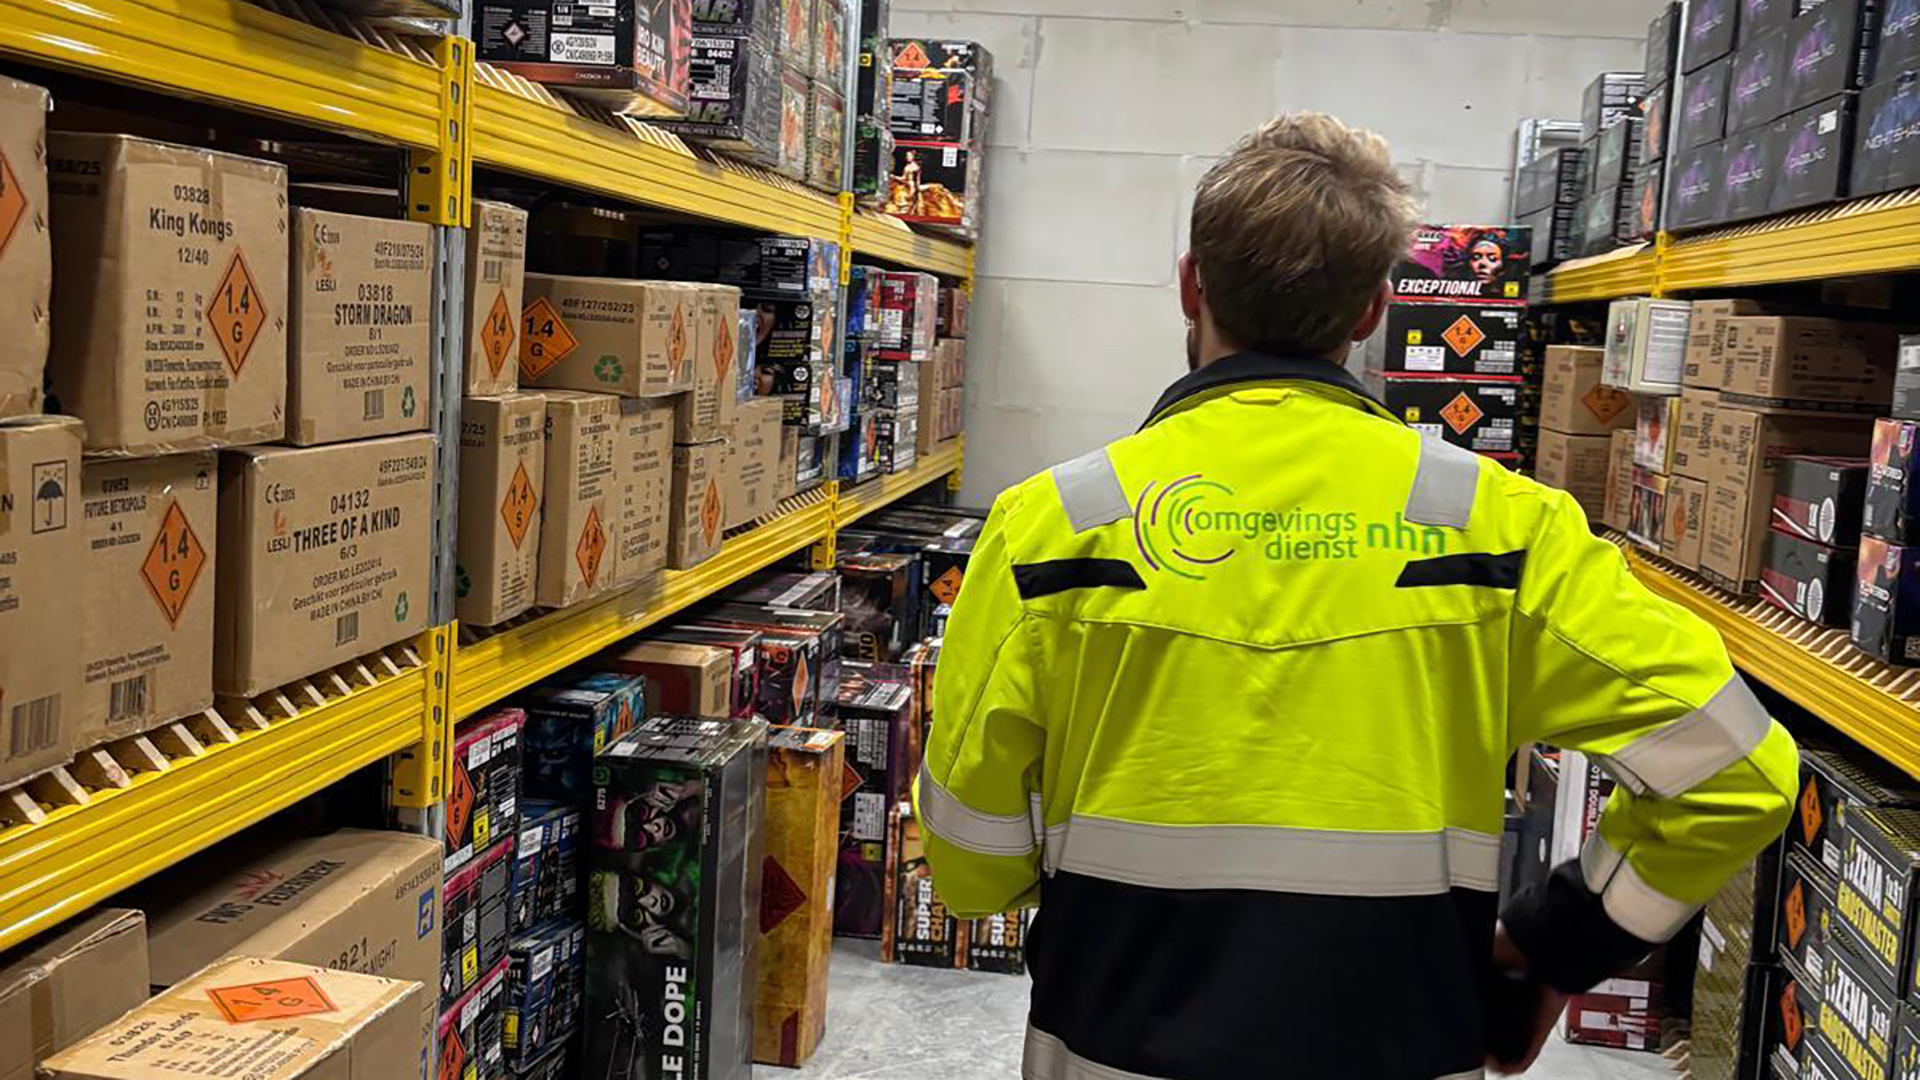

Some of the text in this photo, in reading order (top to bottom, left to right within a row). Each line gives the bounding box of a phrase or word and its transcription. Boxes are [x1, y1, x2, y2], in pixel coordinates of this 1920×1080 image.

[150, 207, 234, 242] King Kongs
[178, 247, 209, 265] 12/40
[316, 279, 337, 292] LESLI
[358, 283, 394, 302] 03818
[1397, 278, 1484, 296] EXCEPTIONAL
[225, 283, 250, 315] 1.4
[334, 303, 413, 326] STORM DRAGON
[232, 321, 243, 343] G
[526, 315, 555, 338] 1.4
[531, 343, 544, 356] G
[331, 488, 371, 515] 04132
[293, 506, 400, 553] THREE OF A KIND
[1194, 507, 1357, 541] omgevings
[160, 528, 189, 563] 1.4
[267, 537, 291, 553] LESLI
[1265, 512, 1446, 561] dienst nhn
[340, 544, 358, 560] 6/3
[169, 570, 180, 591] G
[916, 878, 932, 941] SUPER
[663, 966, 687, 1046] DOPE
[106, 1026, 164, 1063] Thunder
[160, 1010, 201, 1032] Lords
